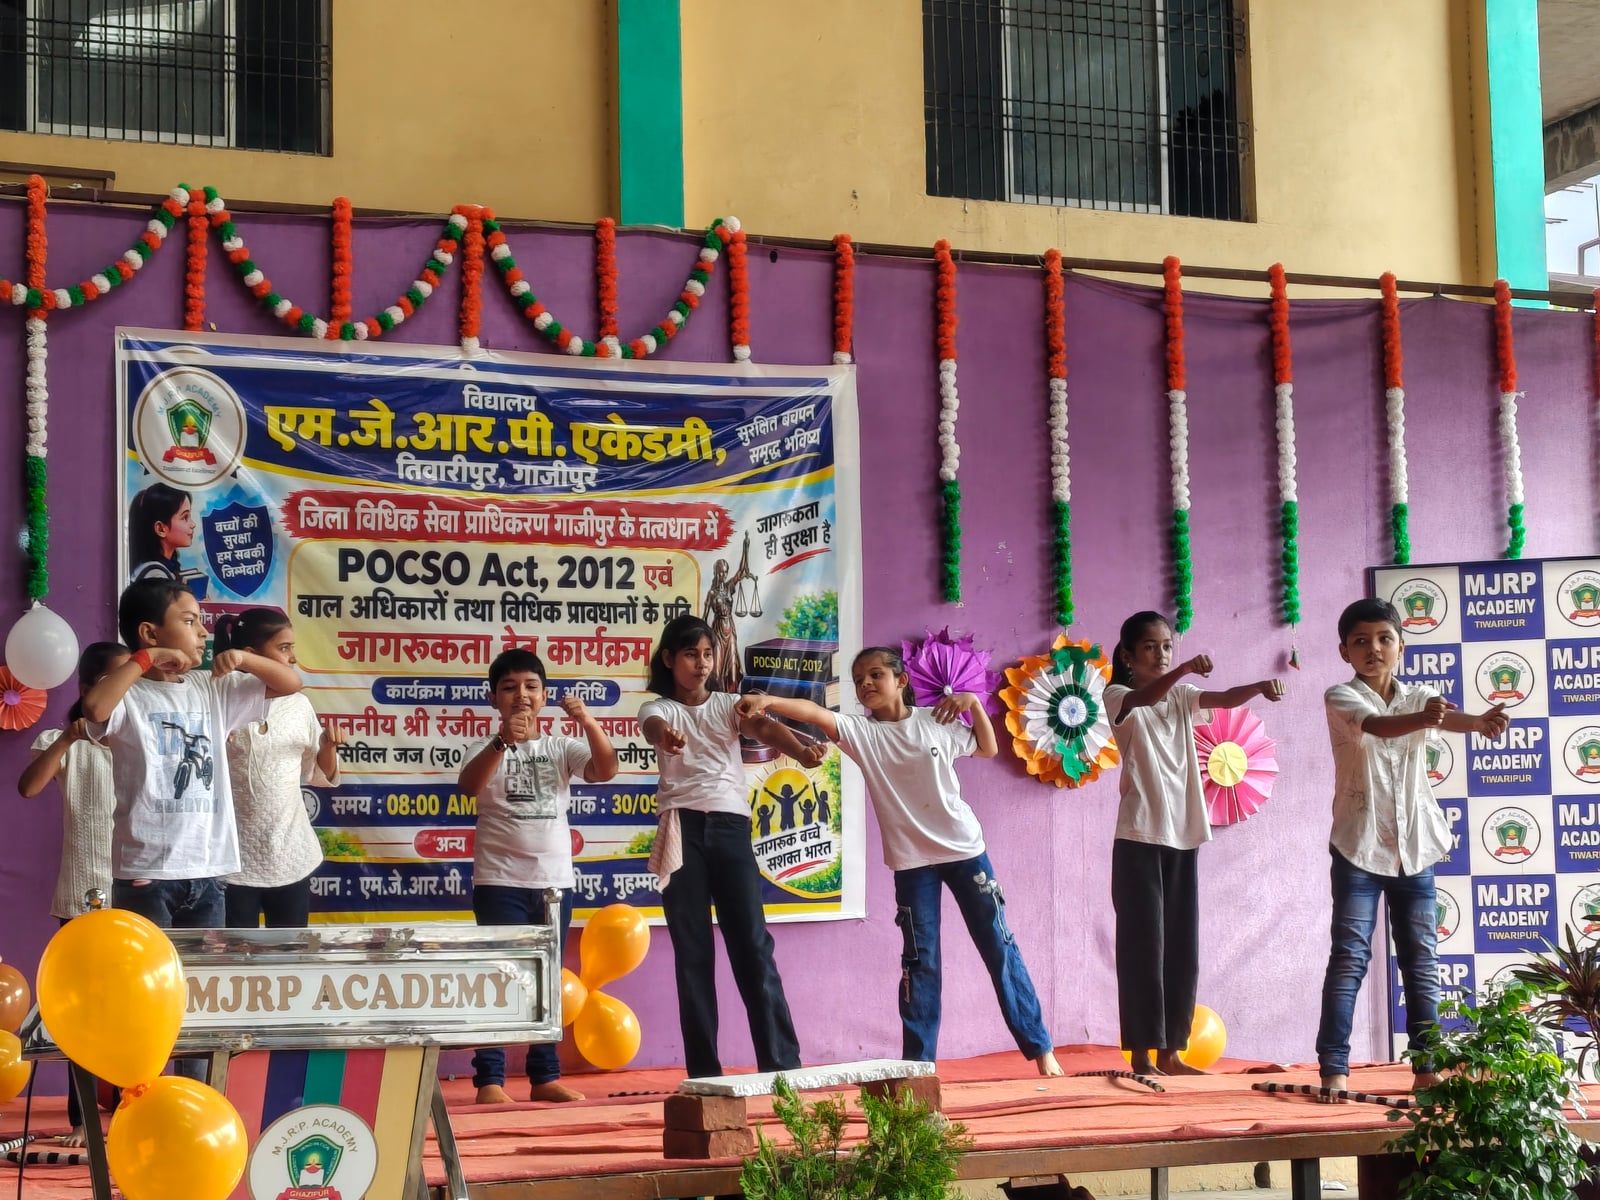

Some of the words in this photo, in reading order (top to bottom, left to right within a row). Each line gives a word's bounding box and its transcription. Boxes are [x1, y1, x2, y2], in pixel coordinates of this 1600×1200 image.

[462, 384, 537, 412] विद्यालय
[736, 415, 778, 446] सुरक्षित
[782, 404, 815, 427] बचपन
[785, 428, 821, 451] भविष्य
[396, 452, 505, 490] तिवारीपुर,
[513, 459, 598, 493] गाजीपुर
[243, 513, 258, 529] की
[298, 496, 350, 530] जिला
[355, 498, 419, 532] विधिक
[423, 501, 460, 533] सेवा
[464, 503, 550, 535] प्राधिकरण
[554, 507, 615, 546] गाजीपुर
[618, 508, 635, 538] के
[703, 511, 719, 541] में
[223, 532, 252, 549] सुरक्षा
[765, 534, 778, 559] ही
[781, 526, 818, 556] सुरक्षा
[216, 551, 232, 564] हम
[339, 548, 470, 586] POCSO
[478, 552, 549, 593] Act,
[557, 555, 635, 590] 2012
[643, 559, 673, 590] एवं
[1464, 572, 1536, 596] MJRP
[297, 594, 344, 618] बाल
[350, 587, 450, 621] अधिकारों
[453, 598, 495, 622] तथा
[500, 591, 562, 623] विधिक
[567, 595, 637, 625] प्रावधानों
[642, 595, 659, 624] के
[1466, 599, 1536, 616] ACADEMY
[1474, 619, 1526, 629] TIWARIPUR
[547, 626, 652, 667] कार्यक्रम
[753, 655, 781, 669] POCSO
[802, 659, 823, 673] 2012
[1552, 646, 1600, 670] MJR
[386, 680, 446, 700] कार्यक्रम
[1554, 673, 1600, 690] ACADE
[1562, 693, 1600, 703] TIWARIP
[404, 707, 430, 737] श्री
[436, 708, 492, 737] रंजीत
[393, 745, 424, 764] जज
[1472, 754, 1543, 771] ACADEMY
[1481, 774, 1532, 784] TIWARIPUR
[331, 796, 372, 815] समय
[386, 794, 439, 816] 08:00
[447, 794, 478, 816] AM
[435, 836, 466, 853] अन्य
[1561, 831, 1600, 846] ACAD
[804, 840, 832, 858] भारत
[1477, 884, 1550, 907] MJRP
[1479, 910, 1549, 927] ACADEMY
[1487, 931, 1539, 940] TIWARIPUR
[186, 974, 301, 1013] MJRP
[312, 972, 515, 1011] ACADEMY
[312, 1118, 358, 1153] ACADEMY
